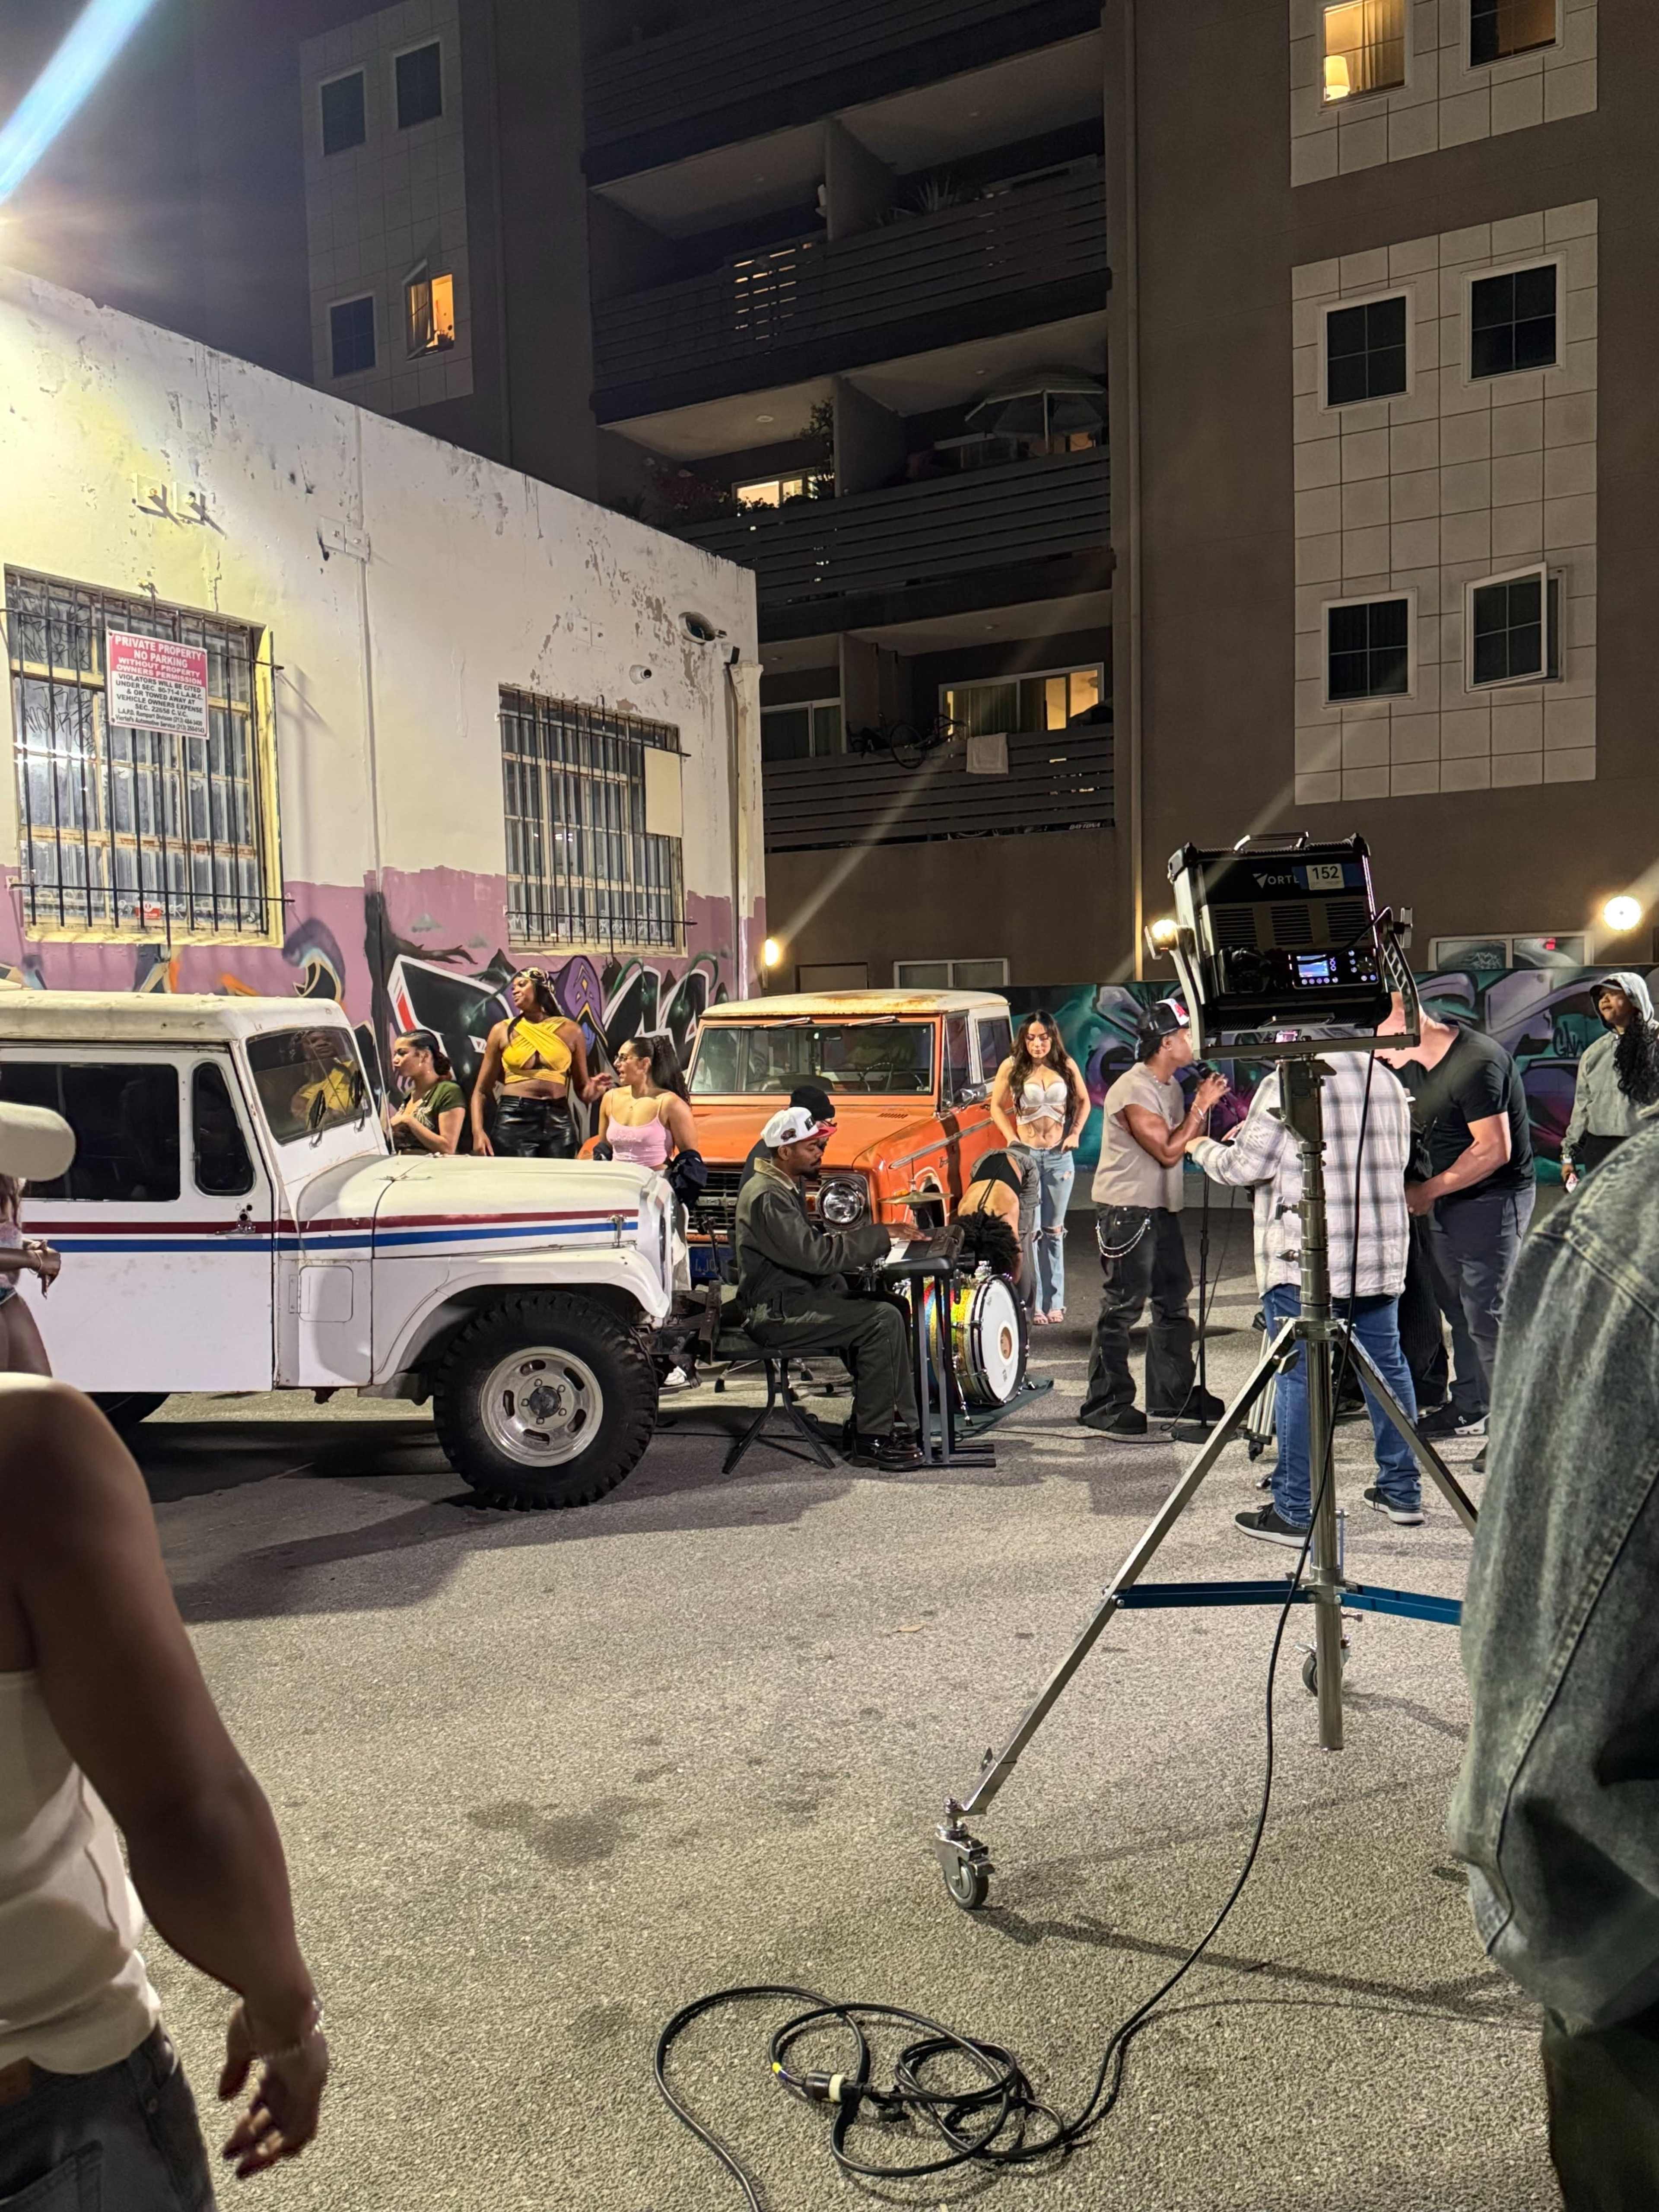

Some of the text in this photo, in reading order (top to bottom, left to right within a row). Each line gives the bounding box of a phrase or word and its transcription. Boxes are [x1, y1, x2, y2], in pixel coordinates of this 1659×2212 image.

[115, 636, 202, 661] PRIVATE PROPERTY
[134, 650, 188, 668] NO PARKING
[116, 664, 202, 685] OWNERS PERMISSION
[118, 657, 200, 678] WITHOUT PROPERTY
[116, 680, 140, 689] UNDER
[118, 674, 157, 684] VIOLATORS
[146, 691, 168, 700] TOWED
[117, 694, 203, 713] VEHICLE OWNERS EXPENSE
[137, 712, 155, 720] Rampart
[1068, 822, 1100, 830] DAYTONA
[1312, 865, 1340, 880] 152
